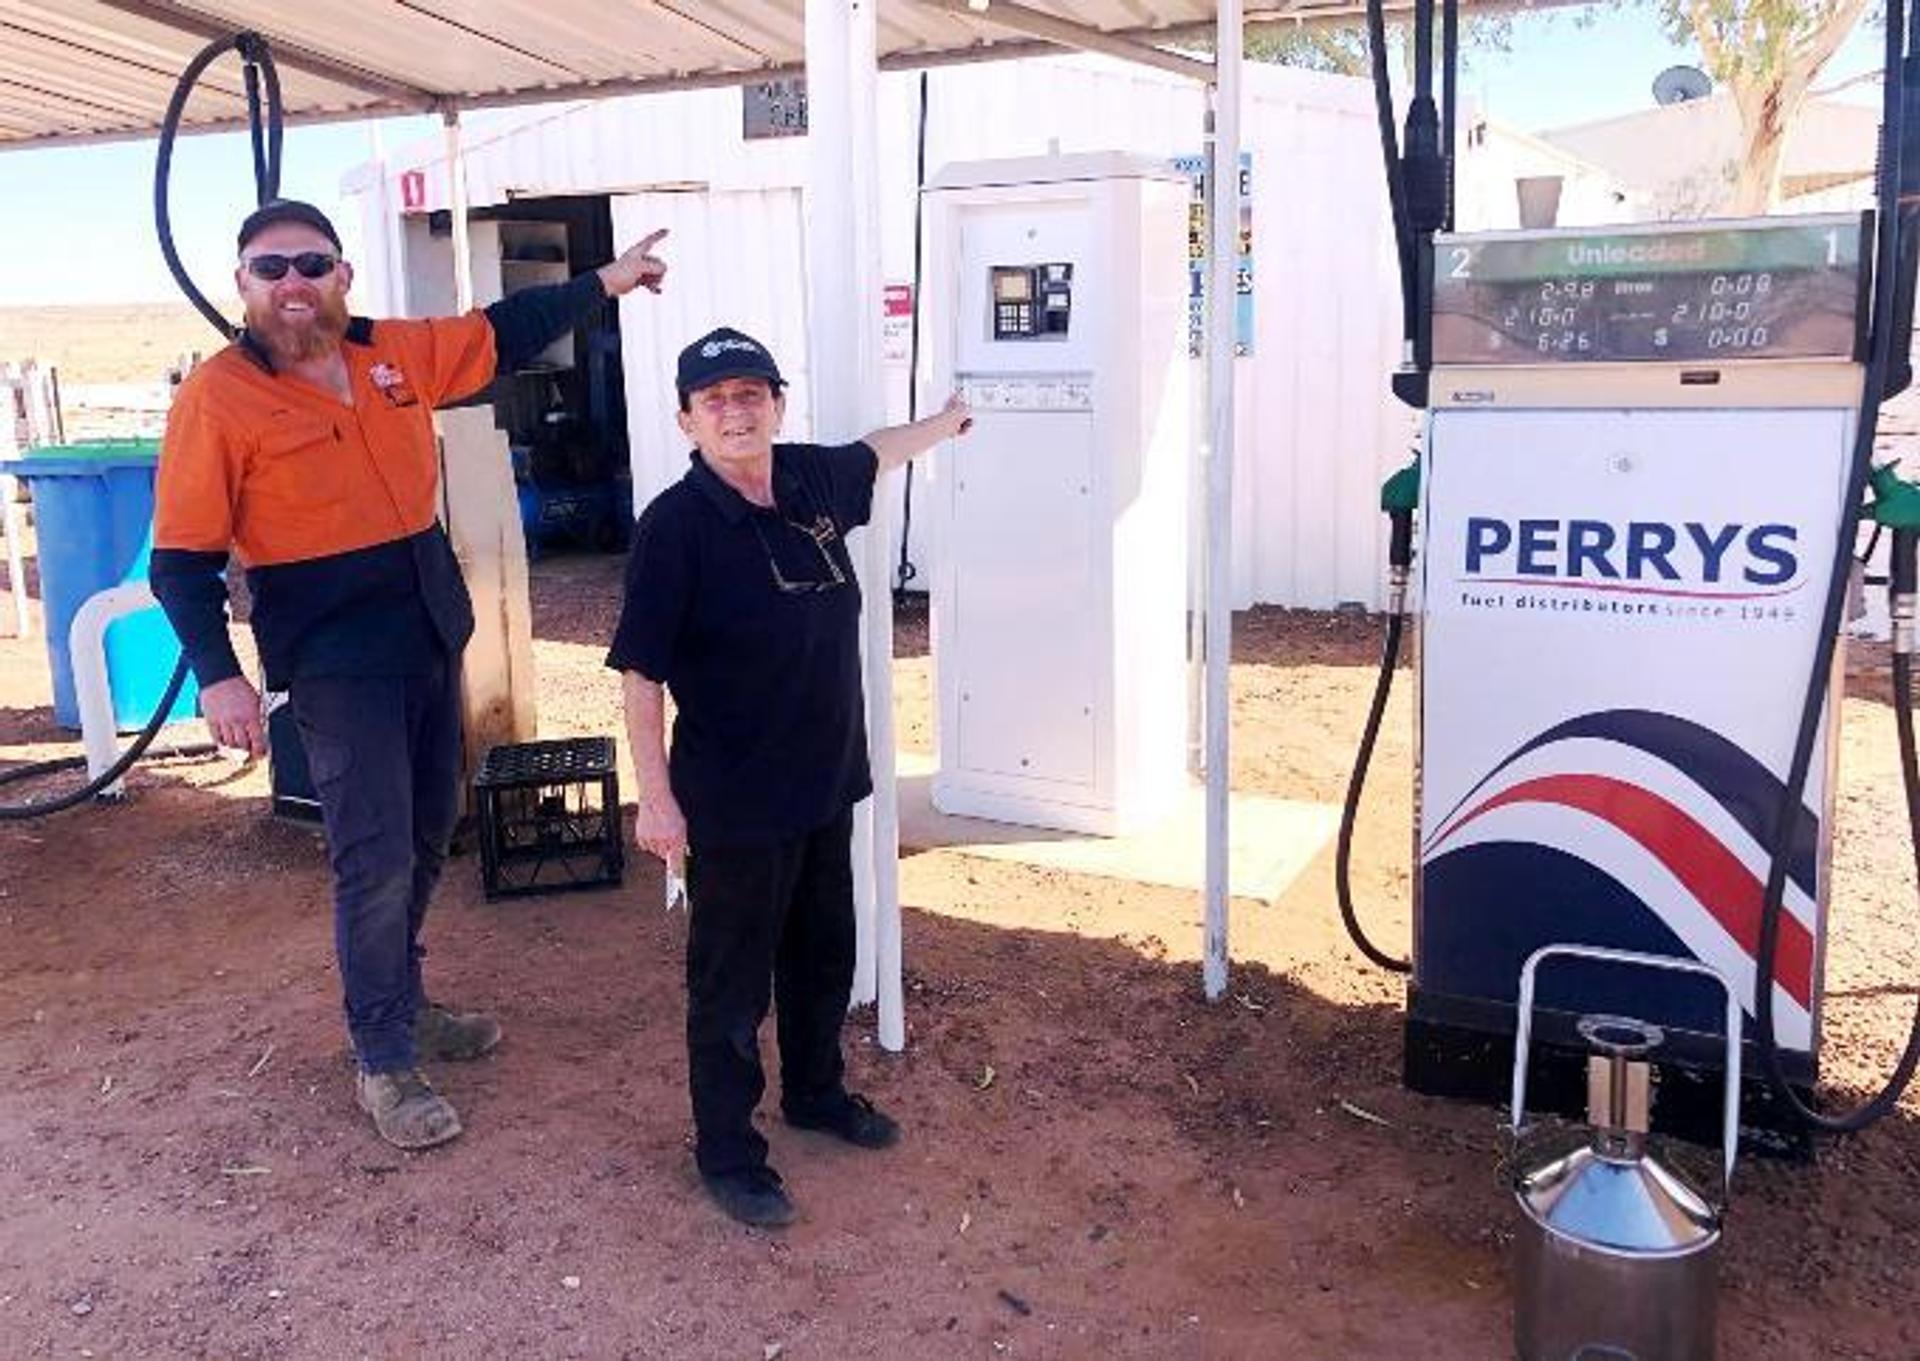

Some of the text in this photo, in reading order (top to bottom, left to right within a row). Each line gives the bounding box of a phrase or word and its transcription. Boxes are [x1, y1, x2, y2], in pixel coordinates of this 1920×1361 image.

[1451, 247, 1471, 278] 2
[1567, 238, 1706, 266] Unleaded
[1823, 234, 1840, 265] 1
[1465, 517, 1798, 586] PERRYS
[1462, 593, 1505, 607] fuel
[1516, 596, 1659, 614] distributors
[1666, 603, 1723, 618] since
